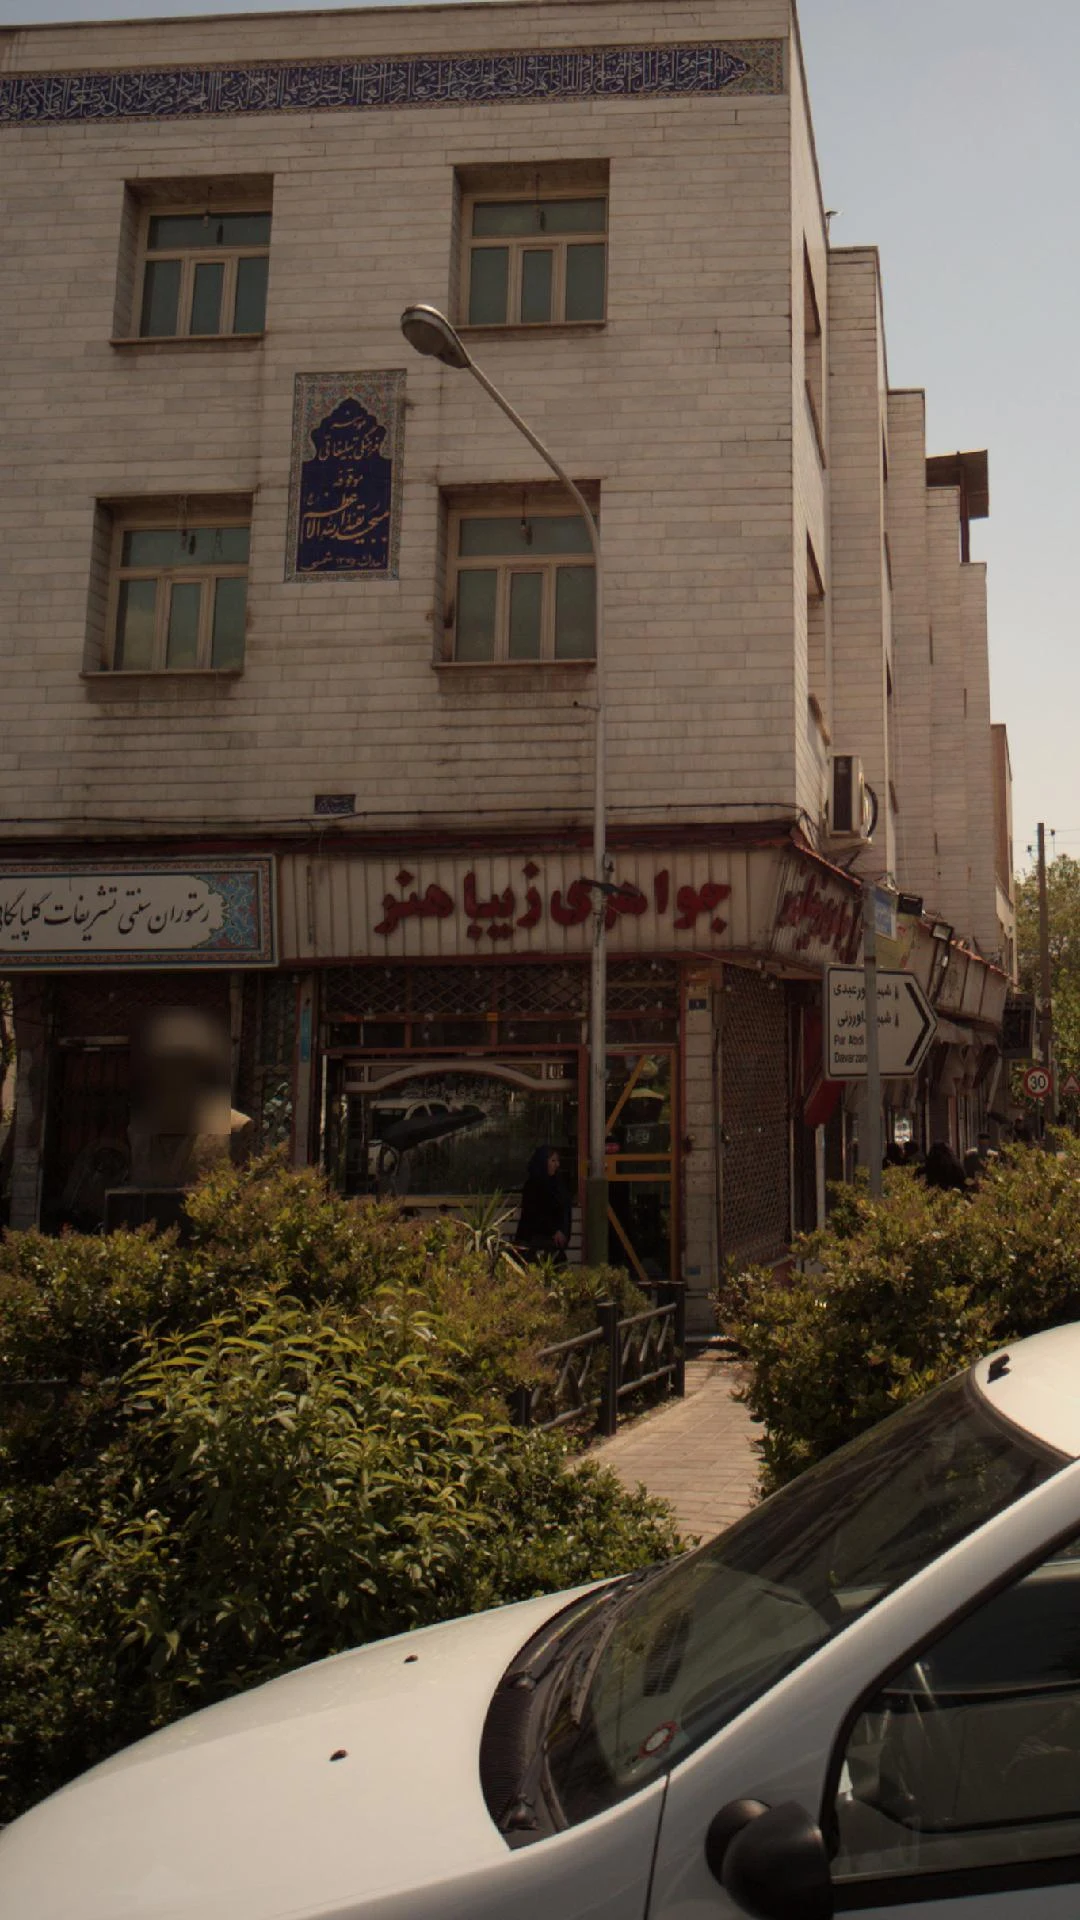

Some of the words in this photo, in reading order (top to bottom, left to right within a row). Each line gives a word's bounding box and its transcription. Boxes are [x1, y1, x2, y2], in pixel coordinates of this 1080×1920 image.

[0, 887, 52, 942] گلپایگا
[44, 885, 117, 941] تشریفات
[118, 887, 151, 934] سنتی
[148, 892, 209, 934] رستوران
[374, 869, 454, 934] هنر
[464, 861, 542, 940] زیبا
[551, 869, 732, 931] جواهری
[833, 984, 866, 1000] ورعبدی
[837, 1009, 866, 1028] اورزنی
[1030, 1075, 1046, 1090] 30
